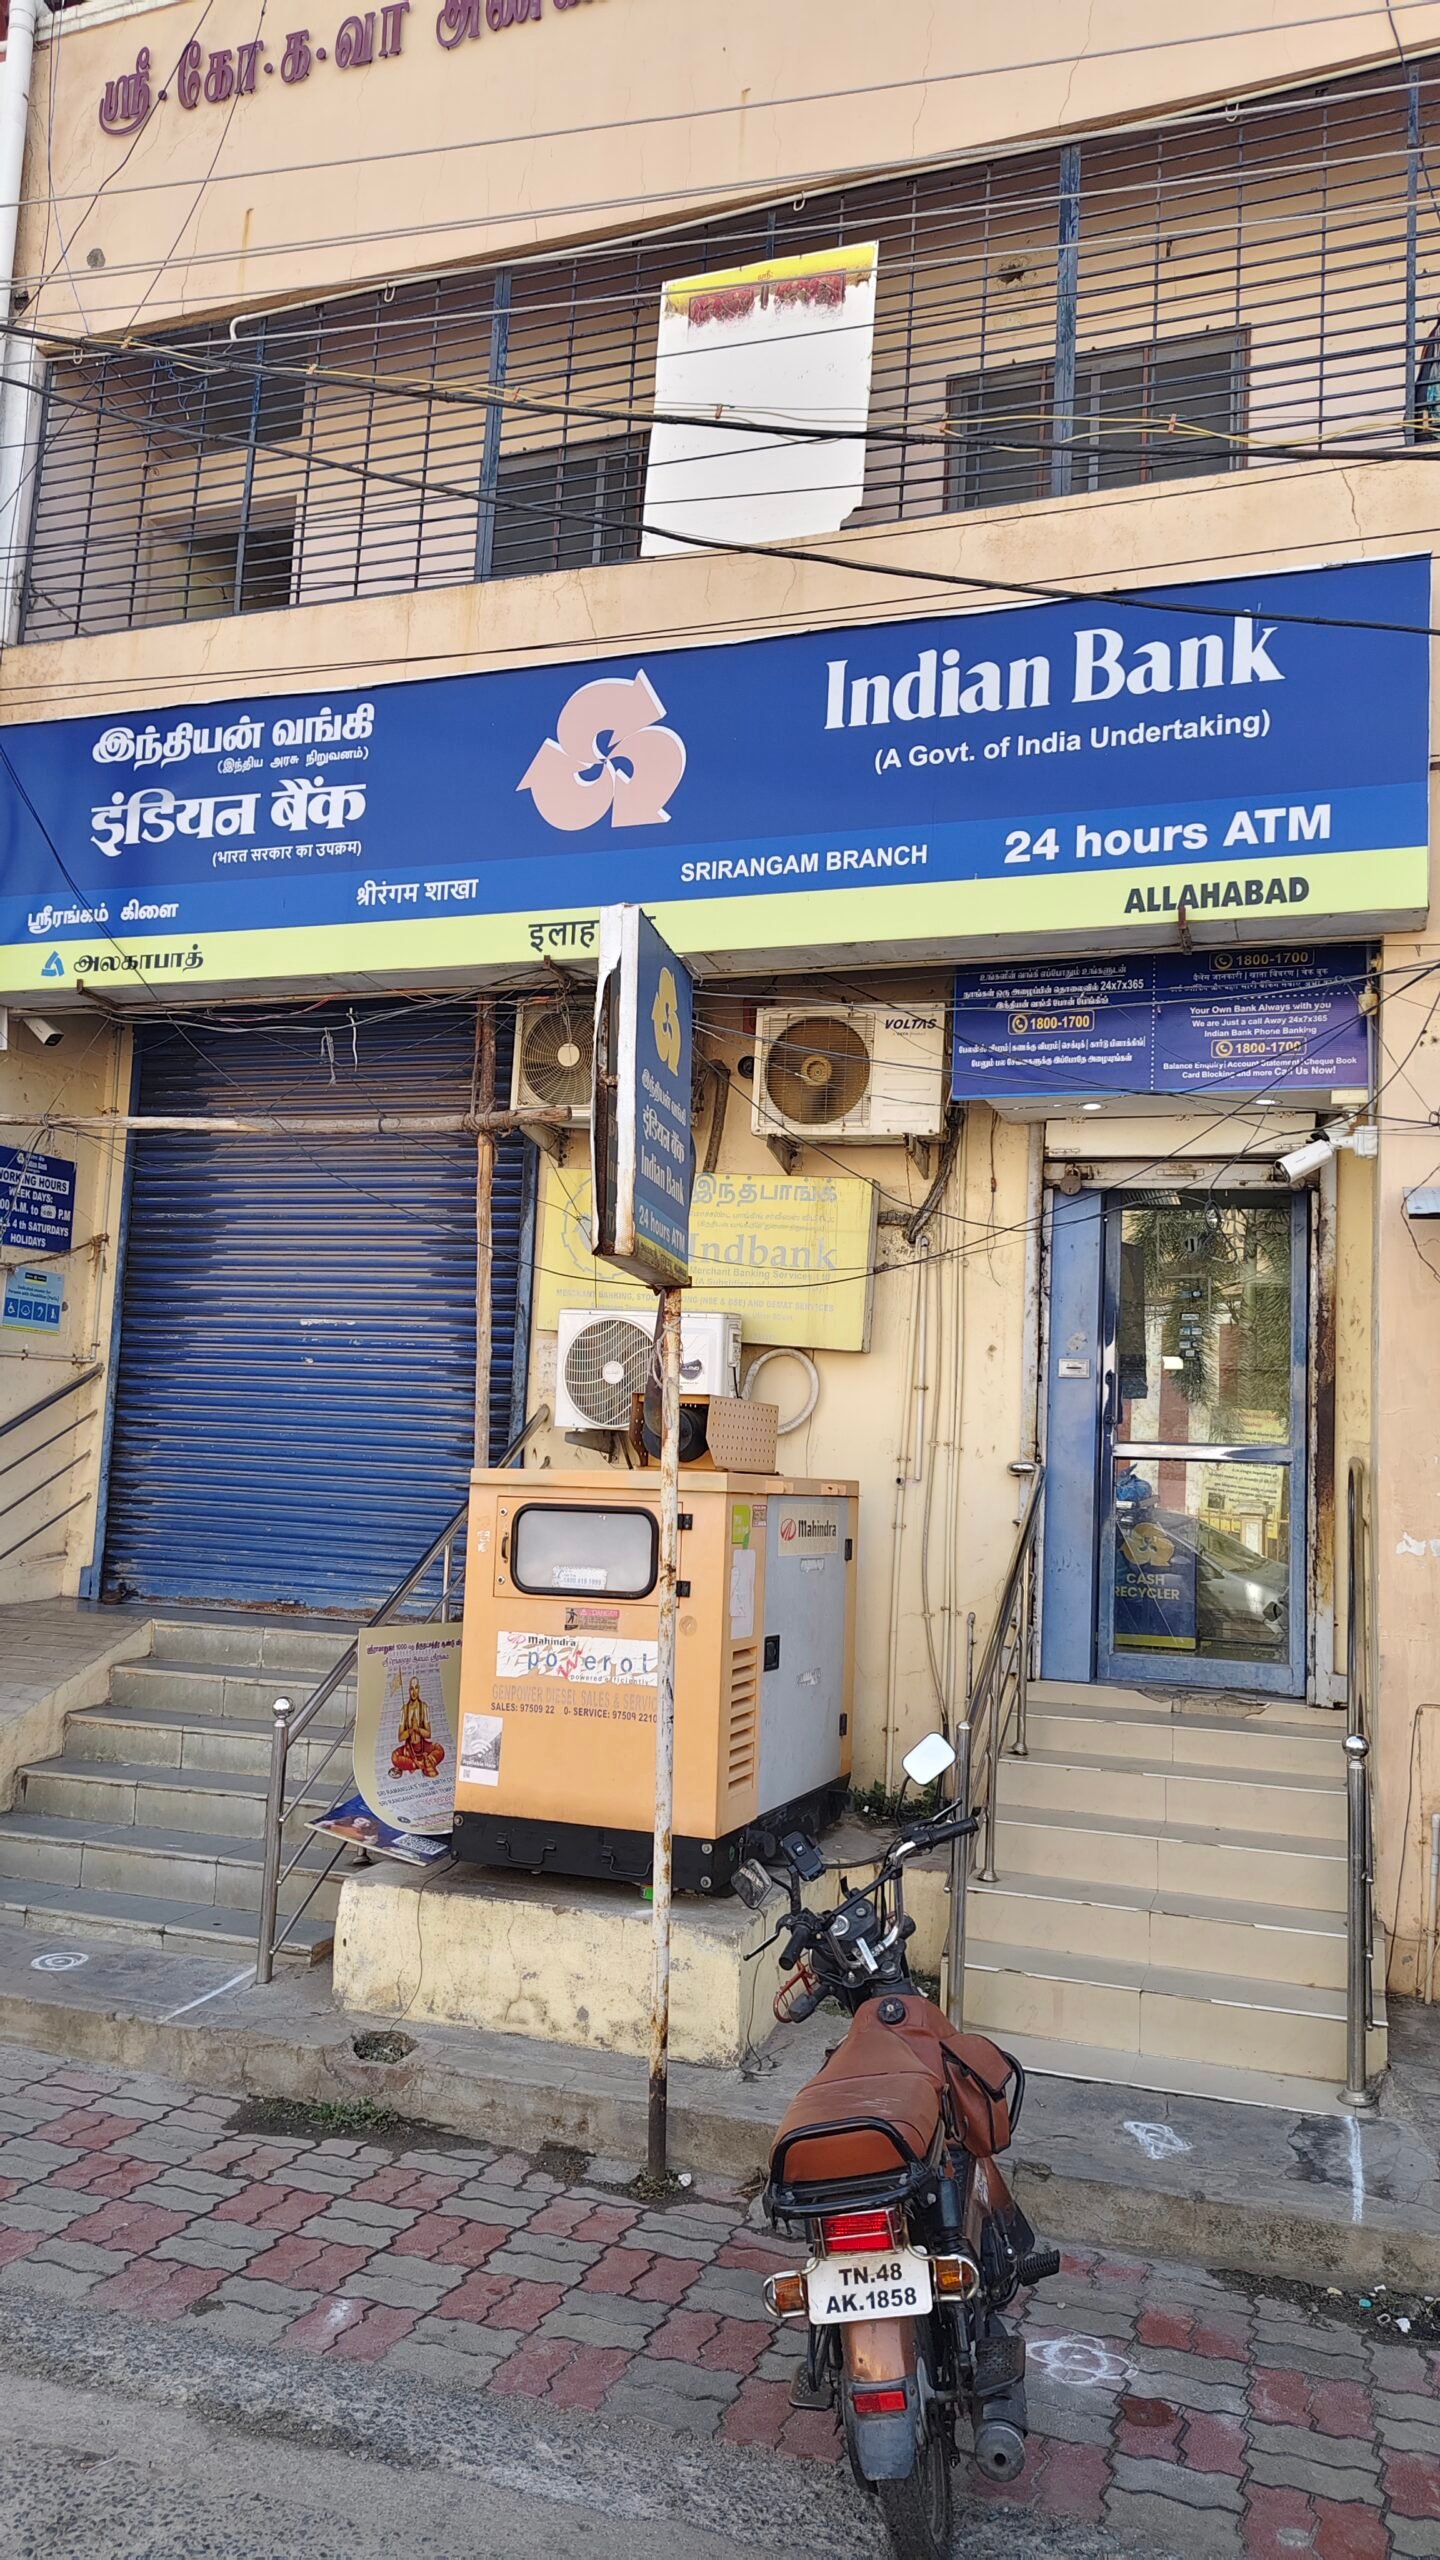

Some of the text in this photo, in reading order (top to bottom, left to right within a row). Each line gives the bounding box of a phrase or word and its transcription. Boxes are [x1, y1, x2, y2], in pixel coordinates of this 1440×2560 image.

[824, 609, 1286, 730] Indian Bank
[92, 703, 375, 772] இந்தியன் வங்கி
[874, 709, 1271, 774] (A Govt. of India Undertaking)
[217, 746, 369, 775] (இந்திய அரசு நிறுவனம்)
[90, 776, 367, 858] इंडियन बैंक
[1004, 803, 1333, 864] 24 hours ATM
[212, 840, 362, 868] (भारत सरकार का उपक्रम)
[681, 844, 928, 882] SRIRANGAM BRANCH
[356, 878, 479, 906] श्रीरंगम शाखा
[1124, 875, 1310, 914] ALLAHABAD
[27, 898, 180, 934] ஸ்ரீரங்கம் கிளை
[73, 943, 205, 973] அலகாபாத்
[1236, 951, 1309, 967] 1800-1700
[1100, 978, 1144, 992] 24x7x365
[1190, 1001, 1332, 1015] Your Own Bank Always with you
[885, 1018, 937, 1030] VOLTAS
[1030, 1014, 1090, 1030] 1800-1700
[1191, 1019, 1205, 1028] We
[1221, 1018, 1239, 1026] Just
[1248, 1016, 1263, 1025] call
[1264, 1016, 1287, 1026] Away
[1288, 1014, 1329, 1024] 24x7x365
[1204, 1025, 1318, 1038] Indian Bank Phone Banking
[1235, 1040, 1302, 1055] 1800-1700
[1163, 1061, 1193, 1070] Balance
[1335, 1056, 1358, 1065] Book
[1182, 1070, 1201, 1079] Card
[1201, 1069, 1235, 1080] Blocking
[1252, 1069, 1273, 1077] more
[1295, 1066, 1310, 1076] Us
[1311, 1065, 1337, 1076] Now!
[641, 1067, 686, 1127] இந்தியன் வங்கி
[641, 1104, 685, 1165] इंडियन बैंक
[0, 1168, 37, 1187] ORKNG
[39, 1178, 67, 1193] HOURS
[641, 1144, 685, 1207] Indian Bank
[32, 1191, 53, 1203] DAYS:
[31, 1204, 39, 1216] to
[57, 1208, 71, 1222] P.M
[12, 1218, 18, 1229] 4
[19, 1220, 27, 1230] th
[28, 1221, 69, 1237] SATURDAYS
[638, 1204, 650, 1230] 24
[650, 1213, 671, 1244] hours
[671, 1226, 686, 1254] ATM
[10, 1232, 46, 1248] HOLIDAYS
[688, 1232, 838, 1270] Indbank
[689, 1266, 731, 1277] Merchant
[733, 1267, 771, 1280] Banking
[772, 1270, 811, 1282] Services
[636, 1291, 659, 1302] STOC
[798, 1519, 837, 1538] Mahindra
[1126, 1572, 1166, 1586] CASH
[1114, 1586, 1180, 1601] RECYCLER
[527, 1635, 577, 1647] Mahindra
[492, 1683, 543, 1703] GENPOWER
[545, 1686, 577, 1706] DIESEL
[581, 1690, 611, 1707] SALES
[623, 1693, 658, 1711] SERVIC
[490, 1702, 518, 1713] SALES:
[520, 1704, 543, 1714] 97509
[573, 1708, 610, 1720] SERVICE:
[612, 1710, 636, 1721] 97509
[838, 2262, 903, 2287] TN.48
[825, 2286, 918, 2315] AK.1858
